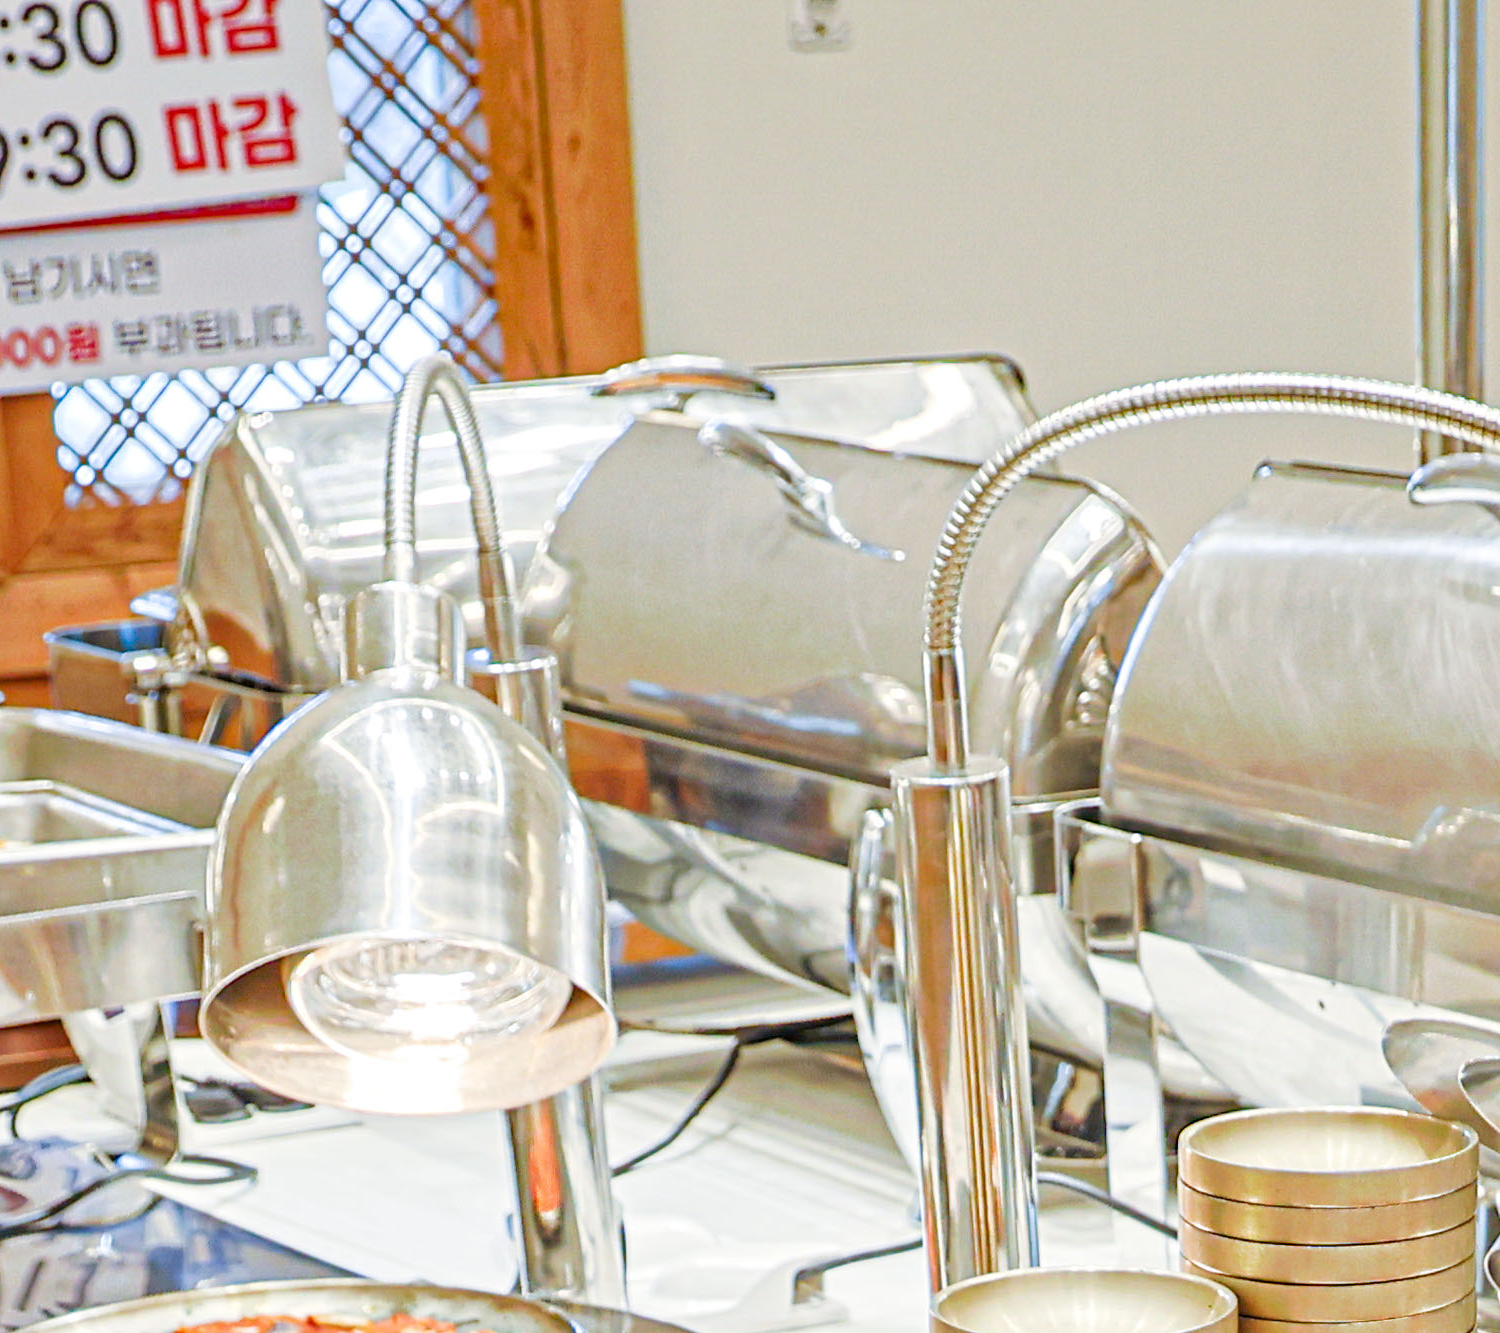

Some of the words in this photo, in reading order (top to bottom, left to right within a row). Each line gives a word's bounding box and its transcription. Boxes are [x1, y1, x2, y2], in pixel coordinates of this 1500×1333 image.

[145, 0, 281, 59] 마감
[164, 92, 301, 174] 마감
[3, 251, 161, 304] 남기시면
